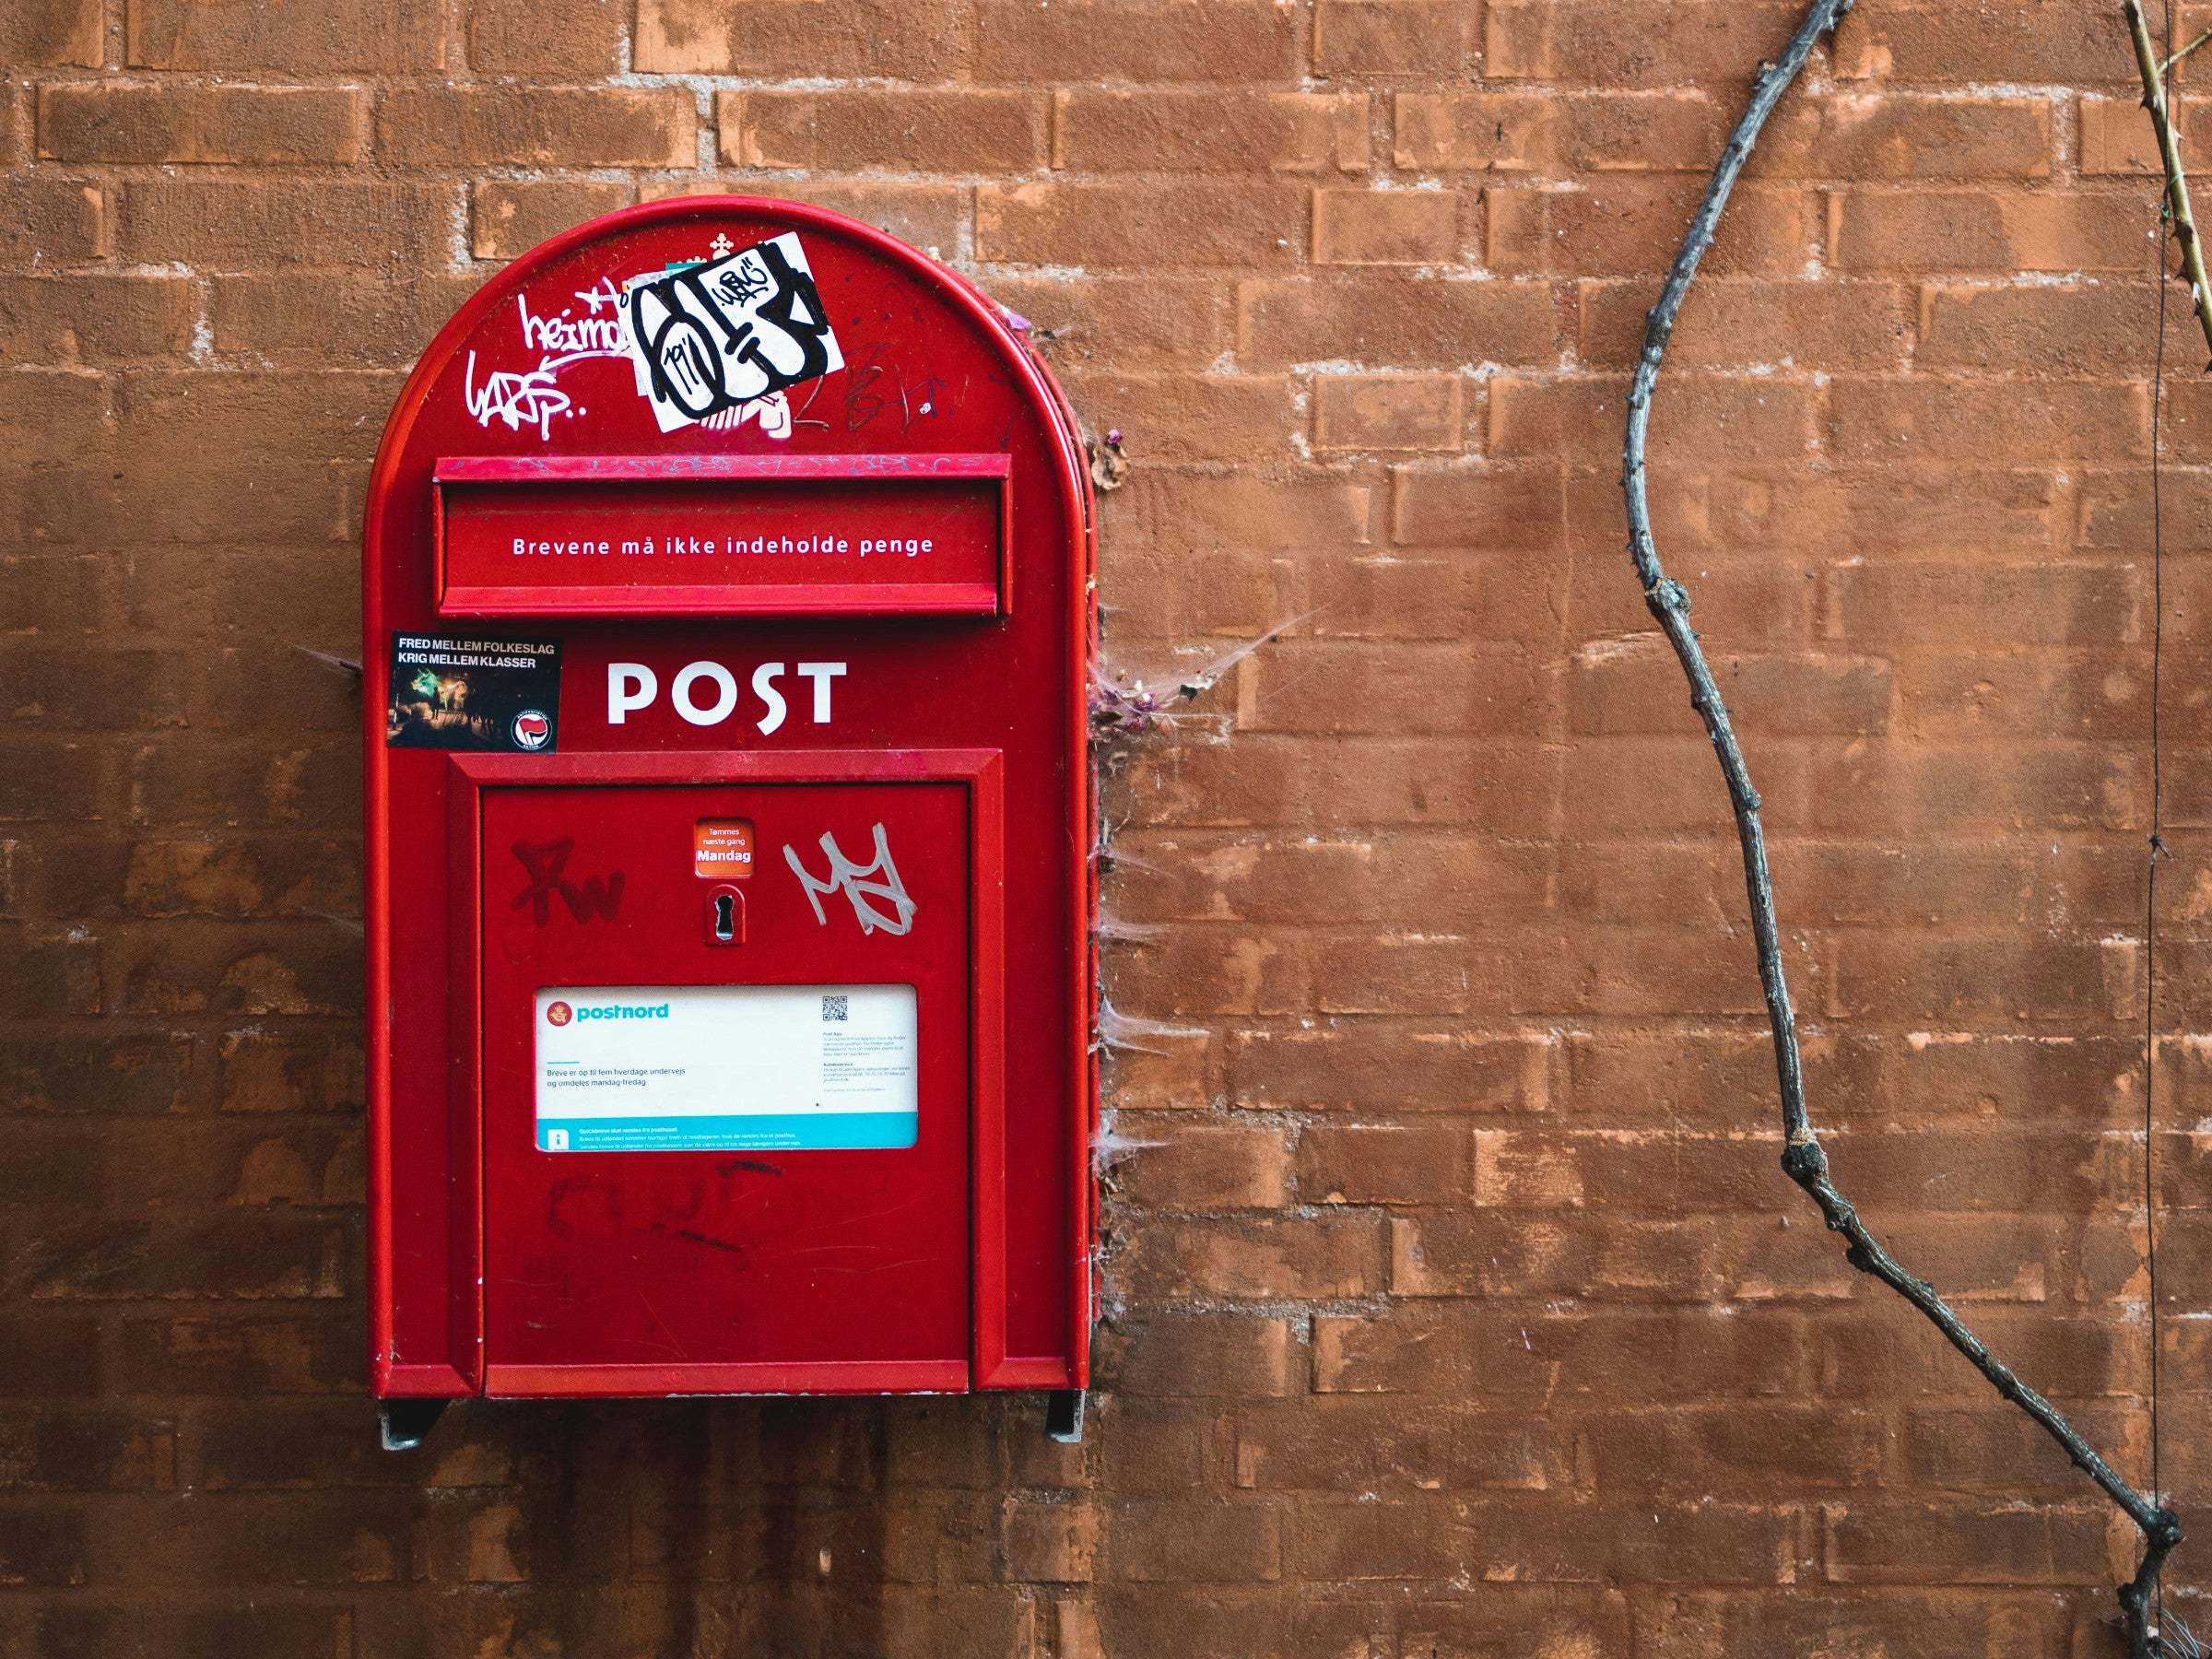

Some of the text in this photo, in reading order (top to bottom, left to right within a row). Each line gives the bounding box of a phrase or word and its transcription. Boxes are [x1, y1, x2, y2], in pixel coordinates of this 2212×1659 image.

[512, 535, 934, 558] Brevene må ikke indeholde penge
[399, 638, 555, 655] FRED MELLEM FOLKESLAG
[398, 653, 536, 669] KRIG MELLEM KLASSER
[607, 660, 847, 736] POST
[709, 828, 740, 836] Tømmes
[697, 849, 751, 864] Mandag
[577, 1004, 669, 1022] postnord
[578, 1070, 589, 1078] op
[614, 1068, 648, 1077] hverdage
[650, 1068, 686, 1077] undervejs
[591, 1078, 647, 1088] mandag-fredag
